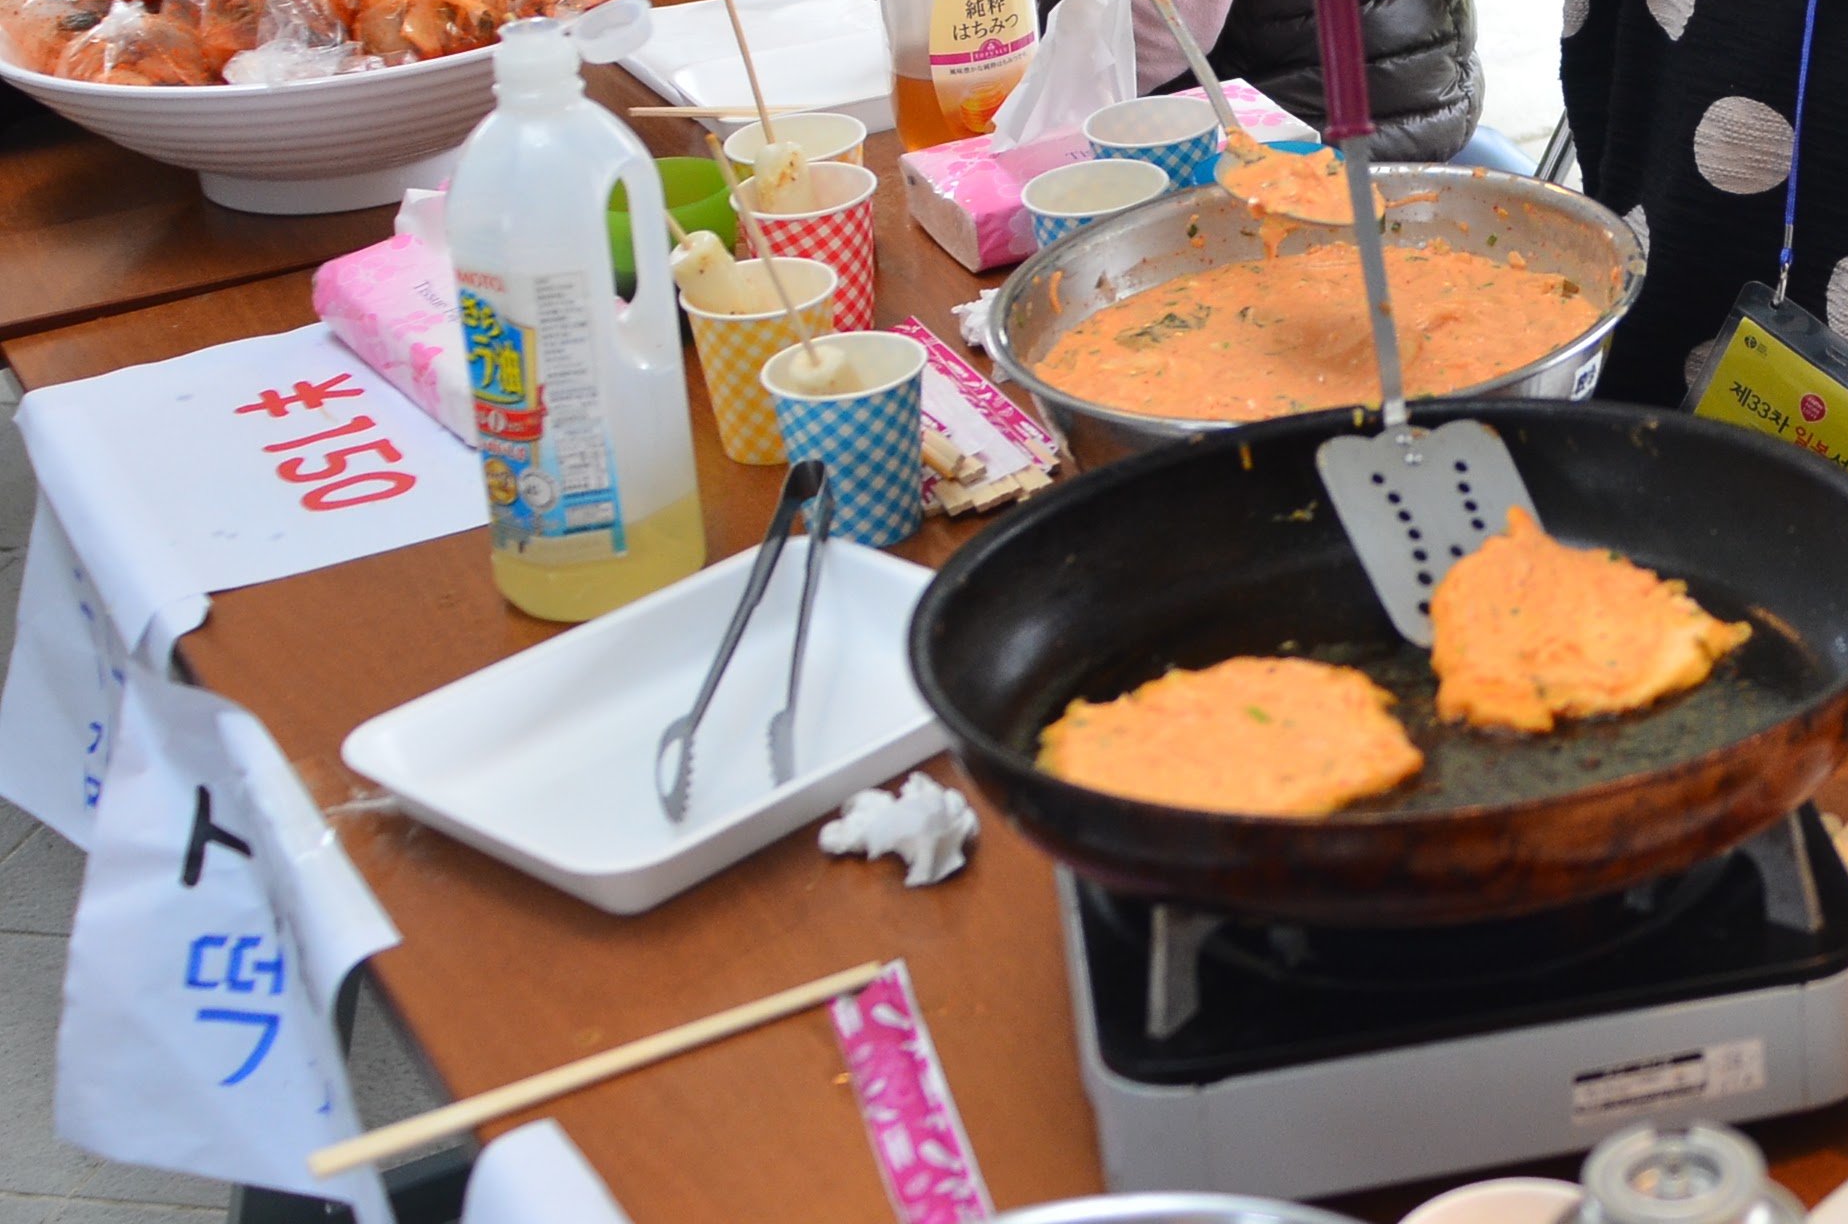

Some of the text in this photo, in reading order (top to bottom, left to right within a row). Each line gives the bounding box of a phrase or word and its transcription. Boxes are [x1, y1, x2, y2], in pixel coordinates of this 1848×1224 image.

[952, 13, 1019, 41] はちみつ
[1729, 380, 1790, 434] 제33차
[234, 373, 416, 511] ¥150
